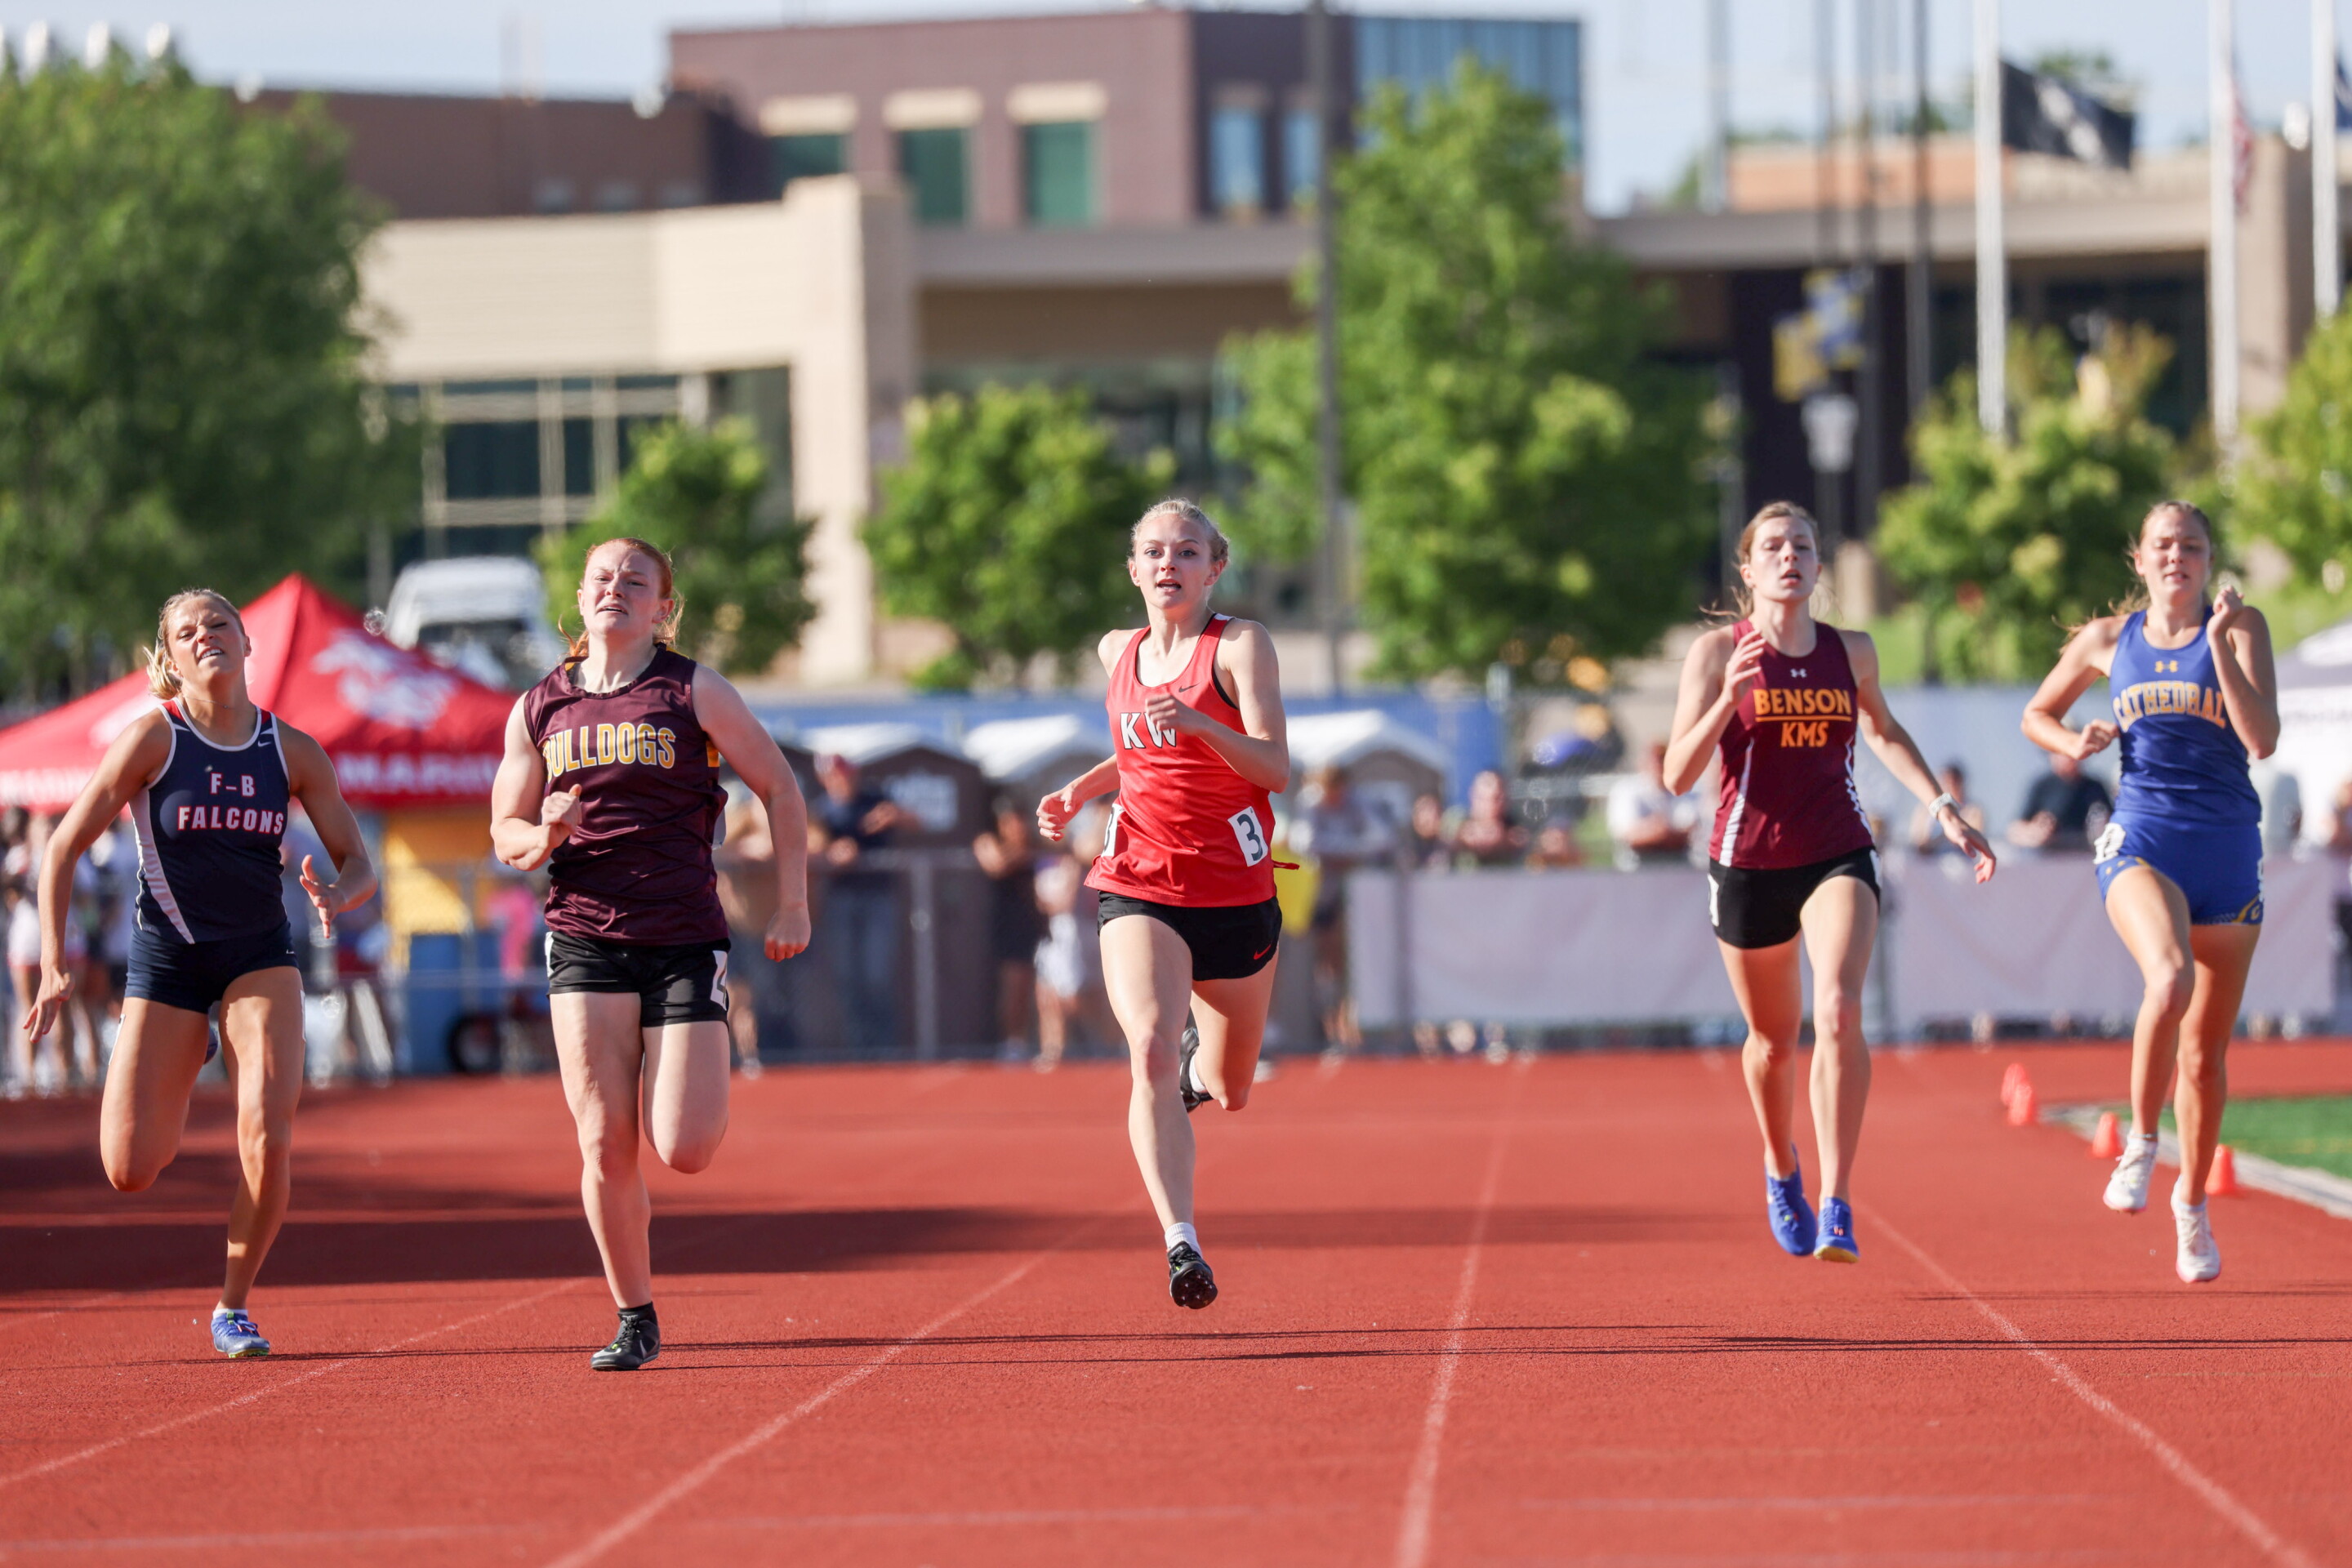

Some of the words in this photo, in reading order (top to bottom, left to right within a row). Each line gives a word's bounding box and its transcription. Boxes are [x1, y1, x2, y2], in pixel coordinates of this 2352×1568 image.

[1753, 688, 1852, 715] BENSON
[2113, 680, 2226, 733] CATHEDRAL
[1781, 721, 1829, 747] KMS
[211, 773, 255, 797] F-B
[177, 805, 284, 835] FALCONS
[1236, 813, 1263, 862] 3
